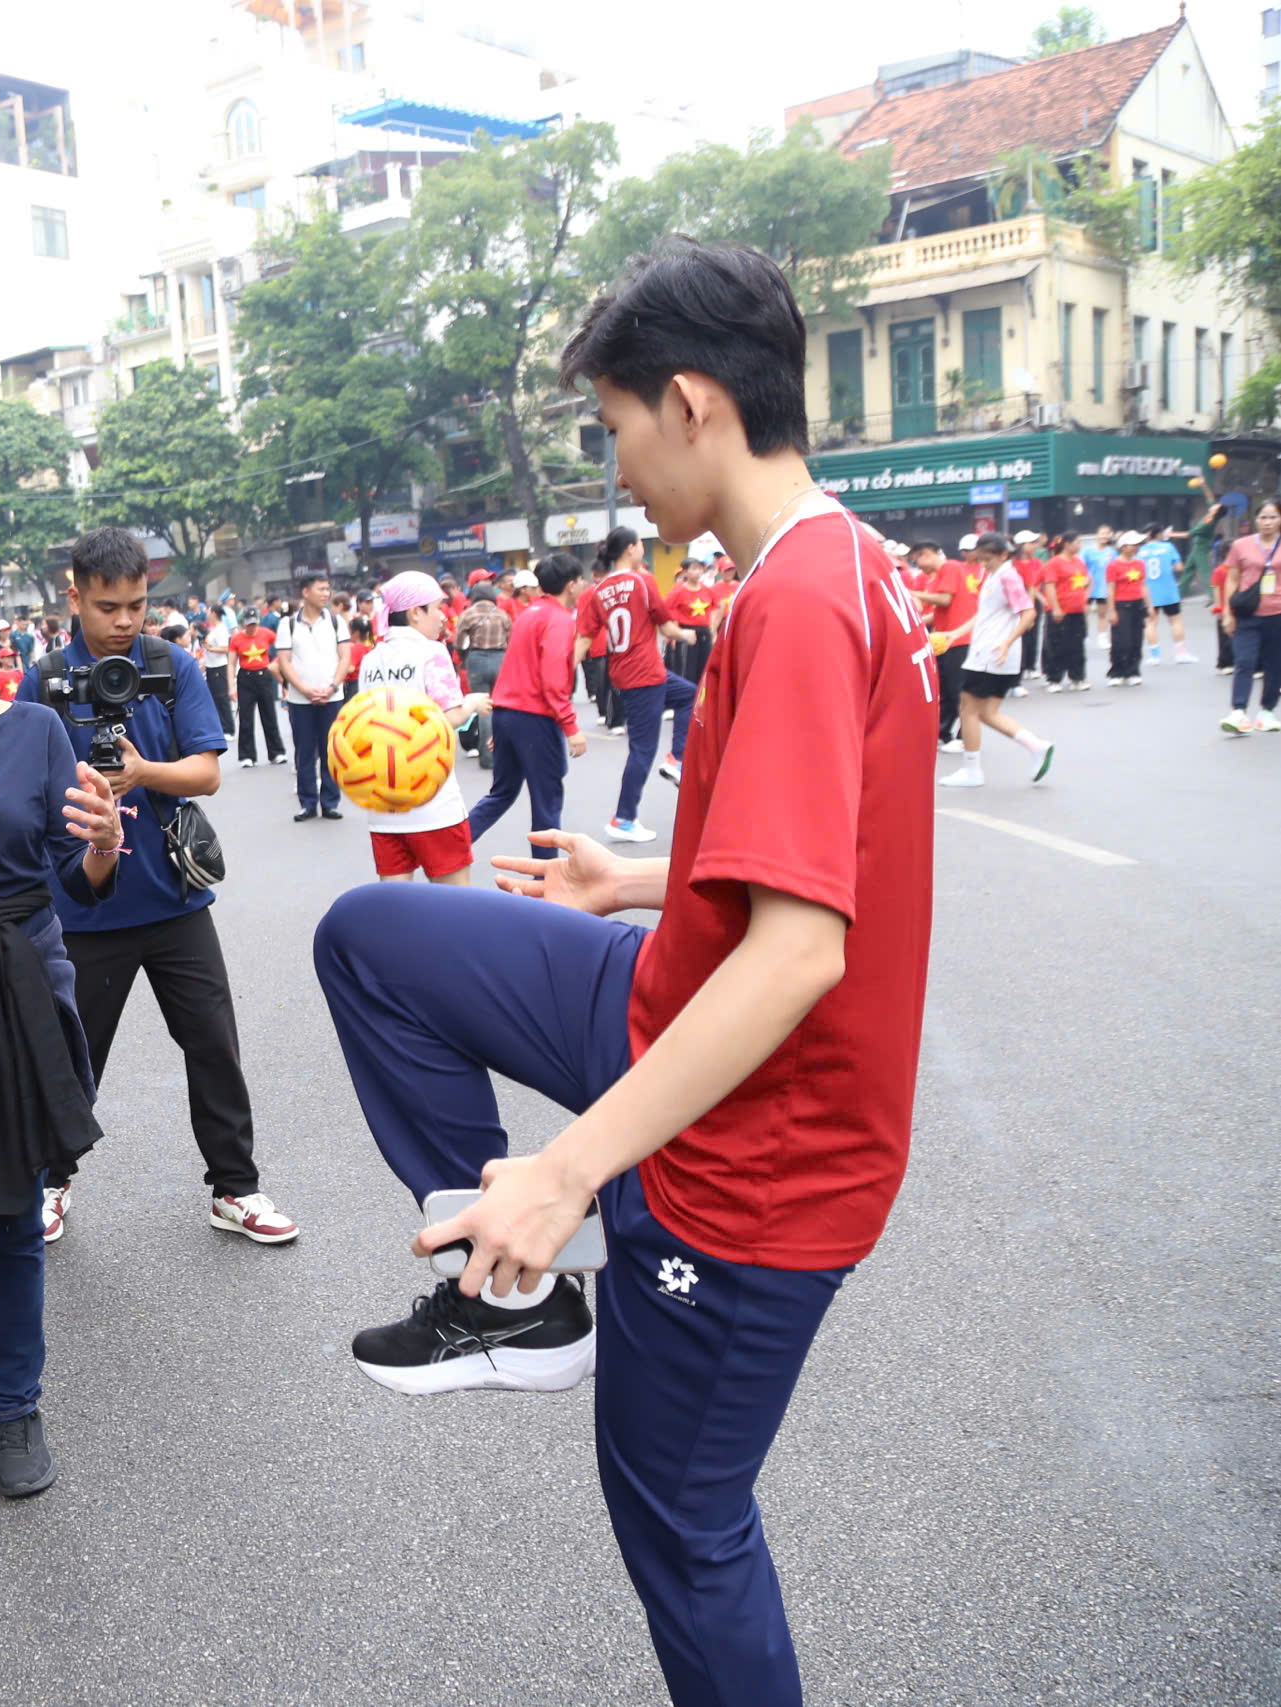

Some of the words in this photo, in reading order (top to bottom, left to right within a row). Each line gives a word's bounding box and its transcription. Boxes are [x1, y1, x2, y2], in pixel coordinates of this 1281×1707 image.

[851, 476, 870, 492] TY
[935, 464, 974, 485] SÁCH
[1000, 458, 1033, 482] NỘI
